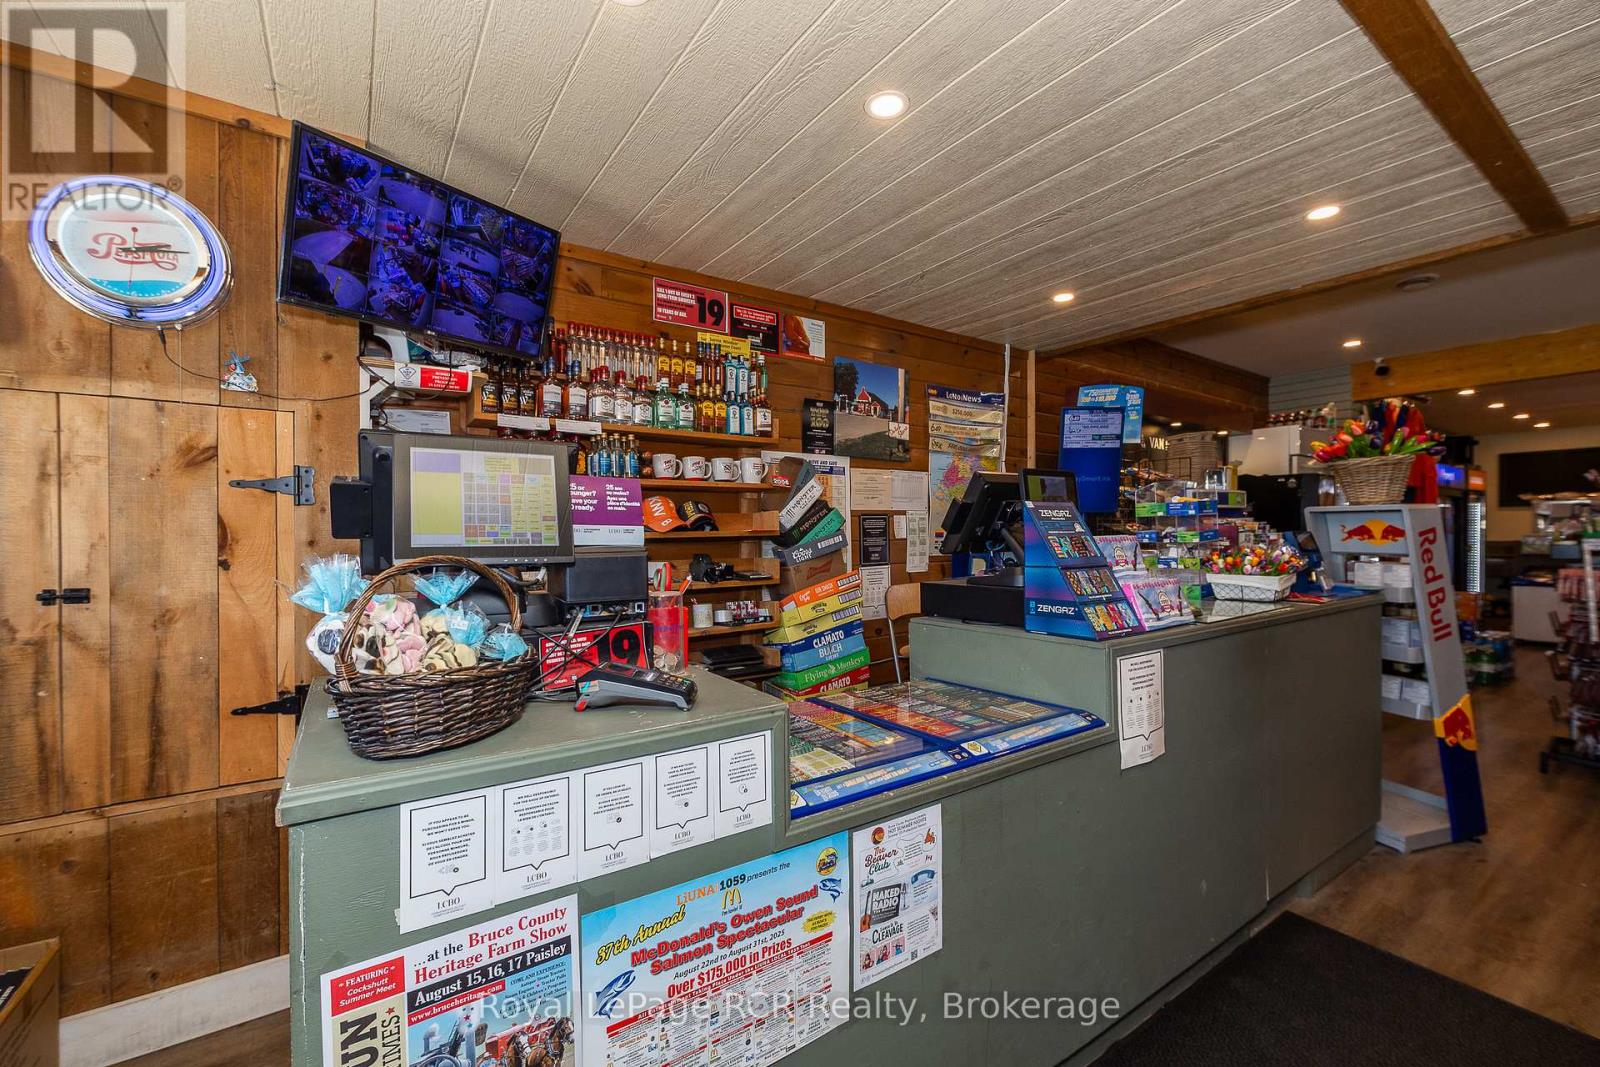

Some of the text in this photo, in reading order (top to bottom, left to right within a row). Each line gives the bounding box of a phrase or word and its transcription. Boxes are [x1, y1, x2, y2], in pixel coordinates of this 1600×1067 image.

[697, 295, 724, 326] 19
[792, 484, 816, 510] MONSTER
[1418, 526, 1452, 642] Red Bull
[1037, 604, 1075, 615] ZENGAZ
[593, 630, 640, 668] 19
[813, 630, 845, 648] CLAMATO
[804, 656, 865, 682] Flying Monkeys
[820, 676, 851, 694] CLAMATO
[605, 851, 623, 861] LCBO
[864, 848, 899, 868] Beaver
[868, 862, 891, 876] Club
[526, 871, 546, 882] LCBO
[720, 874, 746, 890] 1059
[747, 866, 778, 882] presents
[779, 861, 790, 870] the
[437, 896, 460, 909] LCBO
[872, 896, 899, 910] RADIO
[873, 887, 900, 901] NAKED
[444, 942, 463, 956] the
[468, 924, 513, 948] Bruce
[518, 907, 566, 930] County
[595, 905, 686, 965] 37th Annual
[631, 921, 726, 967] McDonald's
[730, 905, 772, 926] Owen
[775, 885, 818, 912] Sound
[872, 924, 904, 944] CLEAVAGE
[414, 923, 566, 983] Heritage Farm Show
[650, 941, 714, 974] Salmon
[717, 907, 804, 948] Spectacular
[673, 928, 785, 980] August 22nd to August 31st, 2025
[346, 966, 388, 986] FEATURING
[416, 944, 566, 1007] August 15, 16, 17 Paisley
[668, 938, 792, 998] Over $175,000 in Prizes
[339, 981, 396, 1007] Summer Meet
[347, 977, 388, 996] Cockshutt
[381, 1014, 402, 1067] IMES
